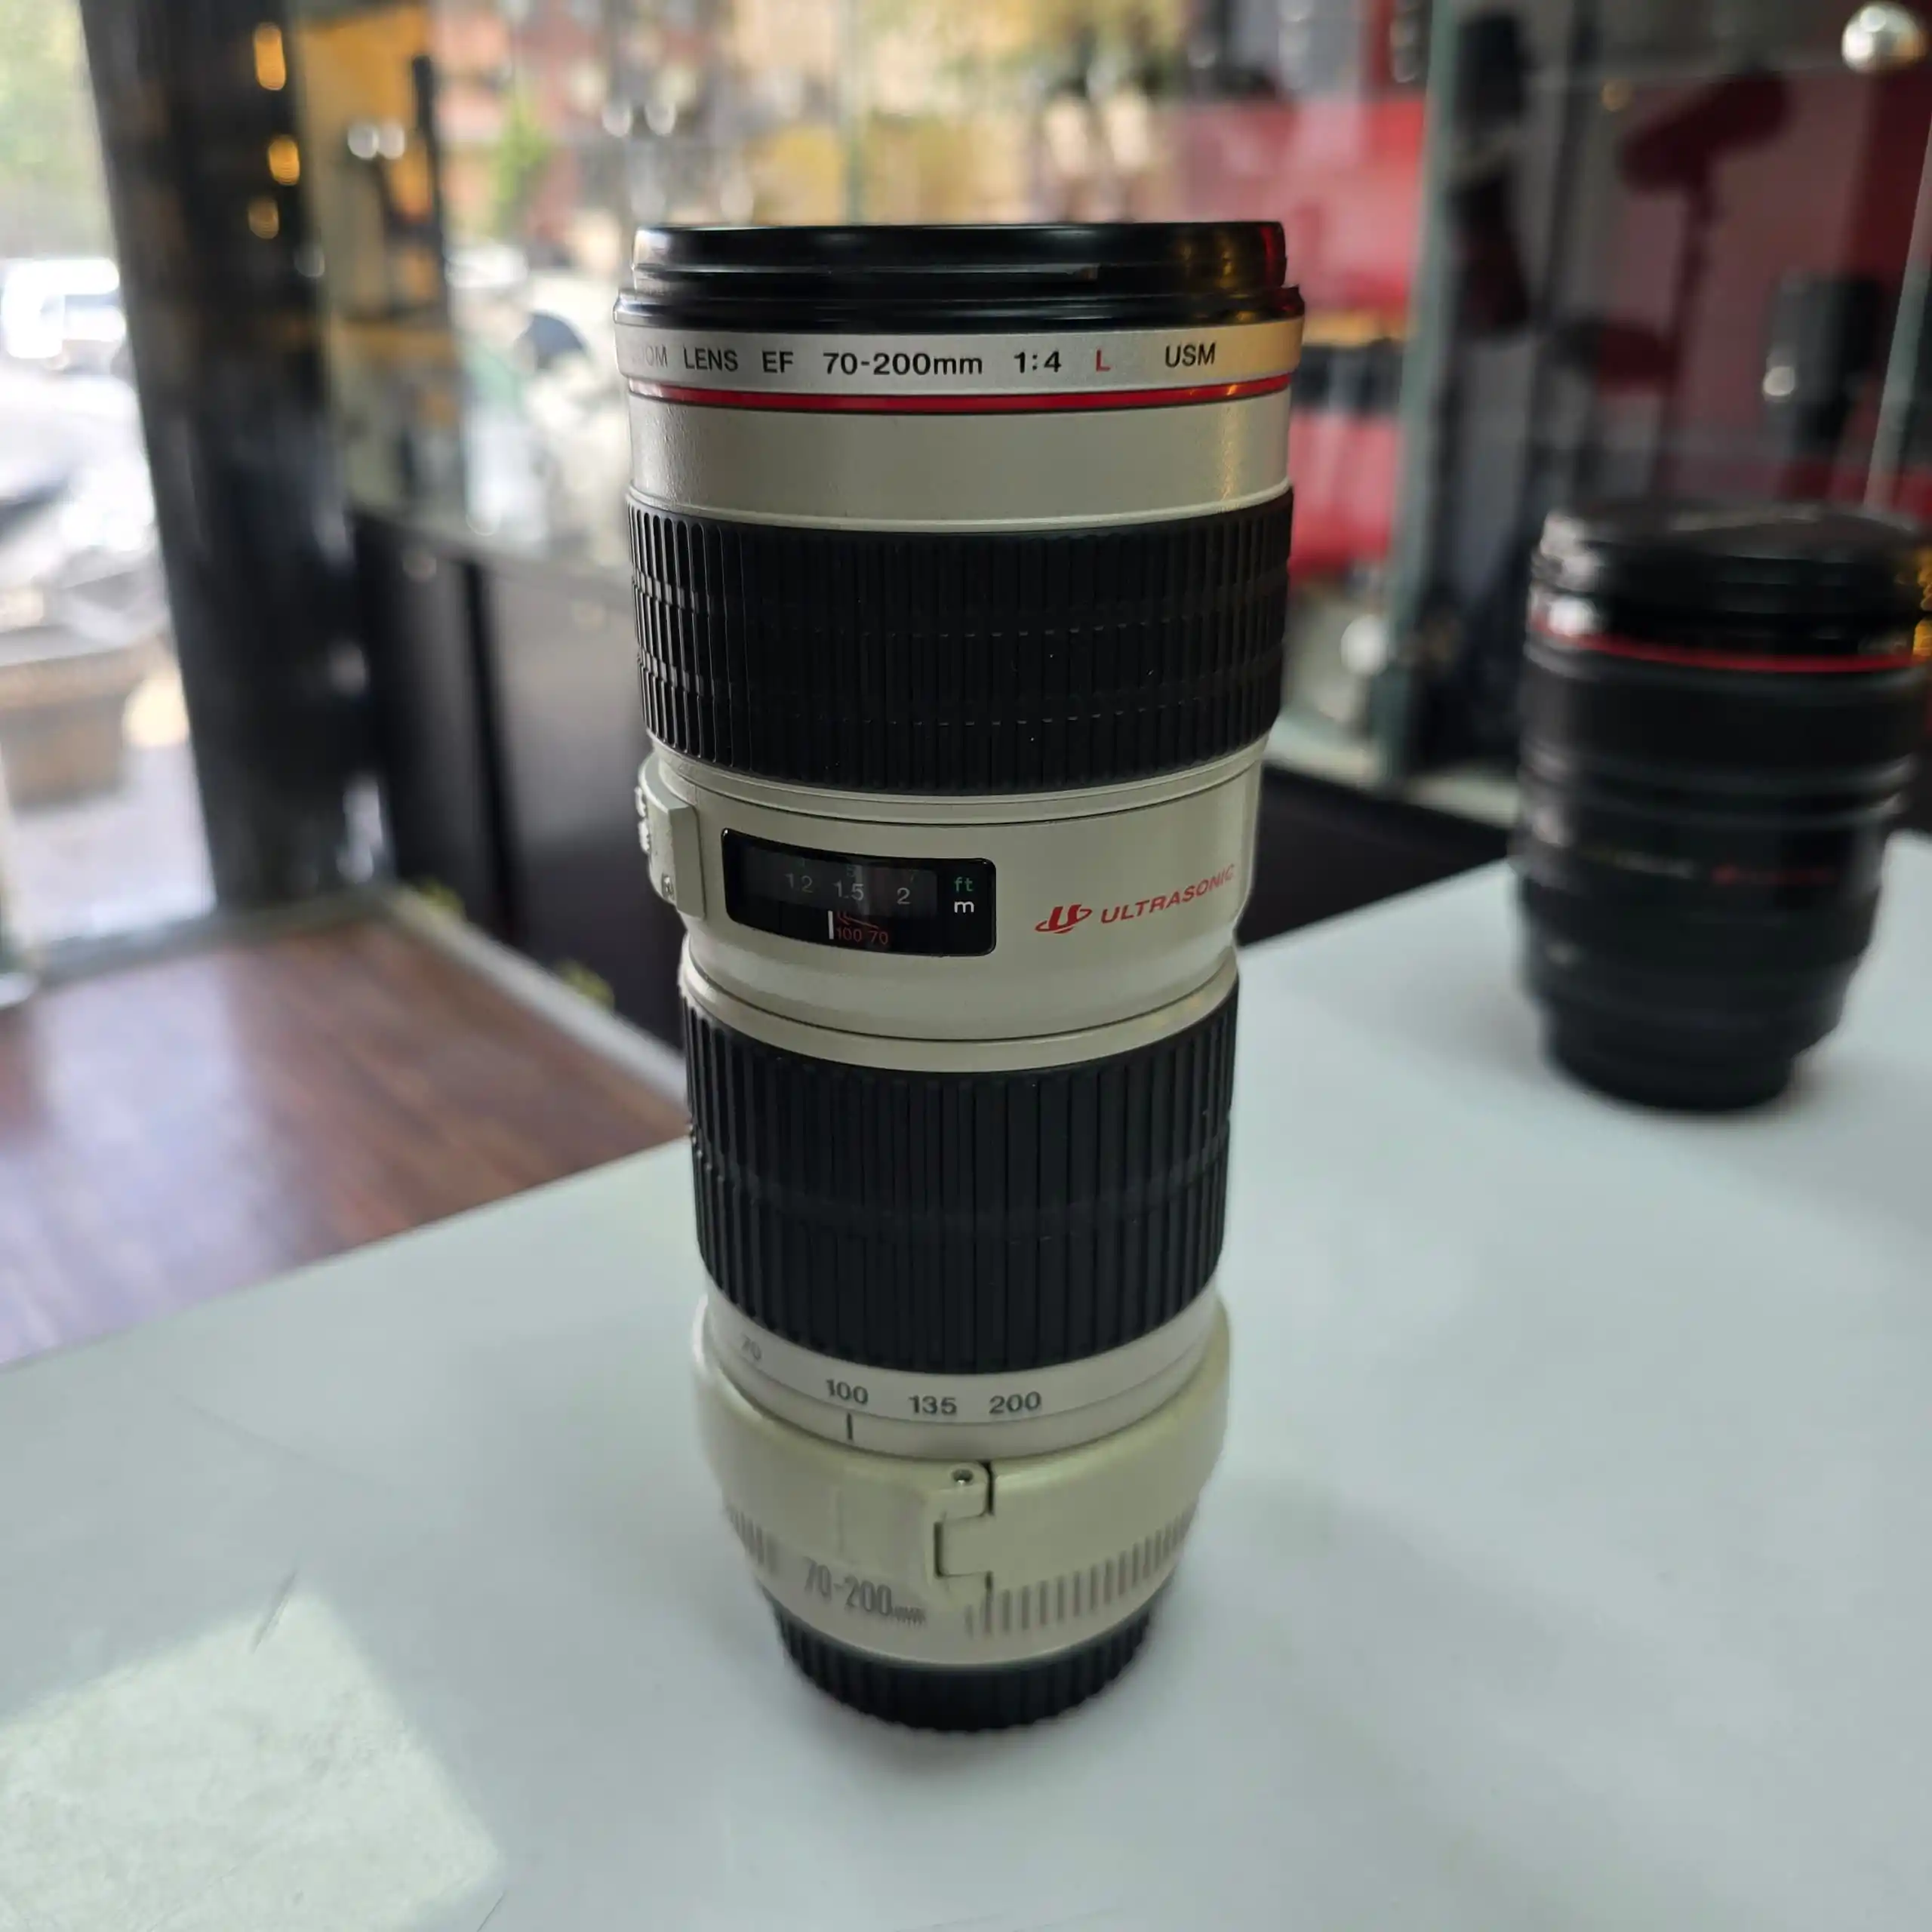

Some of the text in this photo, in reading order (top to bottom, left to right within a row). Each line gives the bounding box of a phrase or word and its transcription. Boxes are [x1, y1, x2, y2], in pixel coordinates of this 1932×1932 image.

[683, 346, 738, 371] LENS
[762, 351, 795, 374] EF
[823, 352, 983, 375] 70-200mm
[1014, 351, 1063, 374] 1:4
[1096, 349, 1111, 371] L
[1164, 343, 1217, 368] USM
[832, 878, 865, 901] 1.5
[896, 887, 912, 905] 2
[954, 876, 974, 892] ft
[1100, 863, 1236, 924] ULTRASONIC
[954, 900, 974, 913] m
[835, 926, 889, 945] 100 70
[826, 1378, 1041, 1416] 100 135 200
